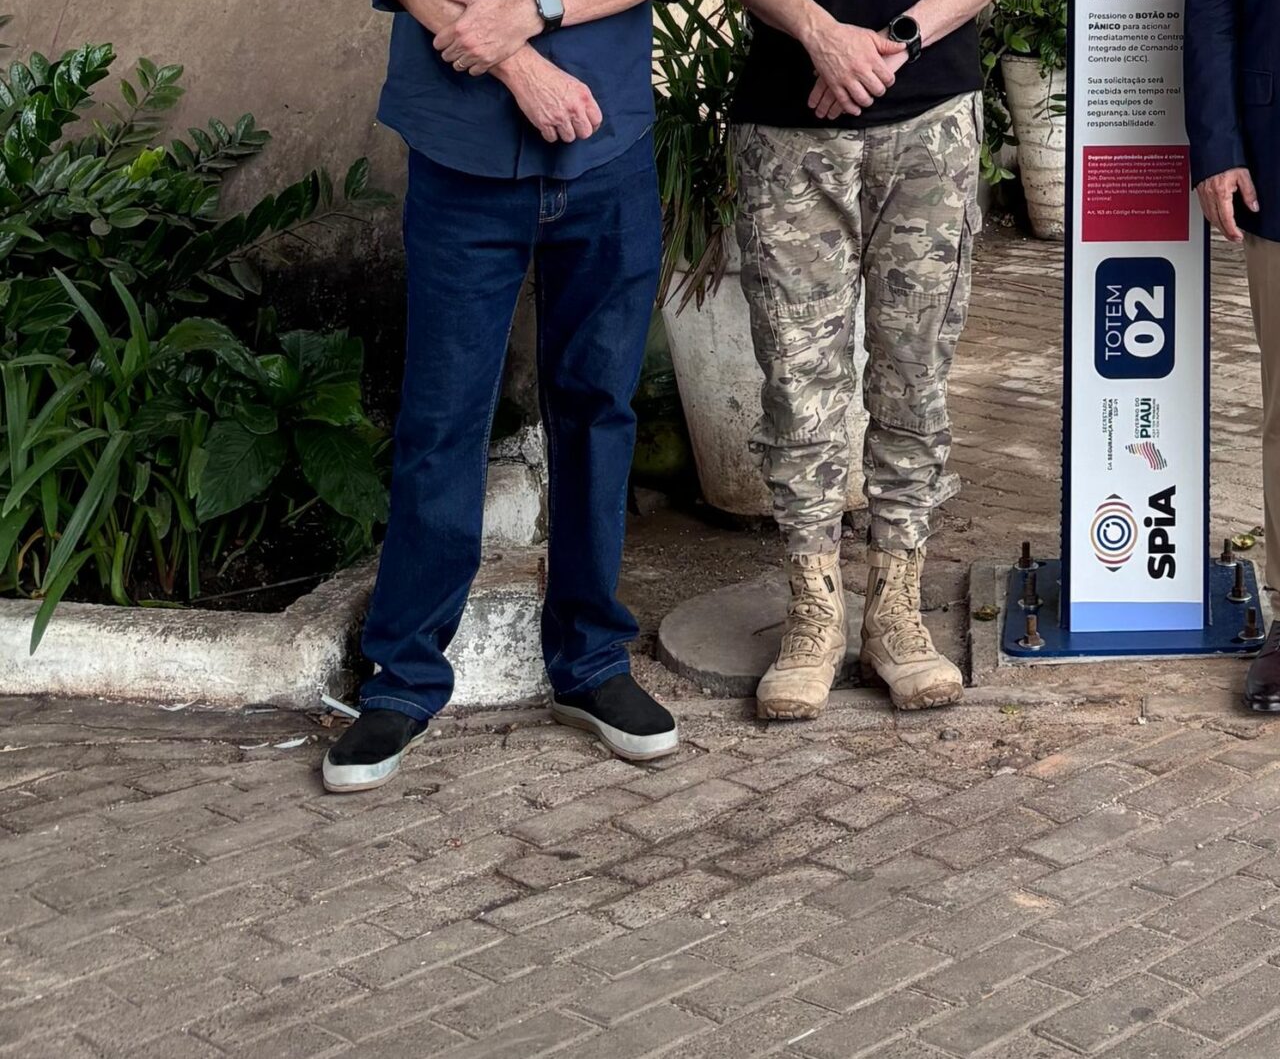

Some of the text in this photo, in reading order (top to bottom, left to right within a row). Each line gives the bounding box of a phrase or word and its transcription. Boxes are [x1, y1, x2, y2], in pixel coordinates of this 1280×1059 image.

[1135, 11, 1165, 19] BOTÃO
[1088, 22, 1121, 30] PÂNICO
[1088, 44, 1127, 52] Integrado
[1104, 77, 1146, 85] solicitação
[1148, 76, 1164, 84] será
[1138, 88, 1165, 96] tempo
[1088, 98, 1109, 106] pelas
[1110, 98, 1141, 106] equipes
[1087, 120, 1157, 128] responsabilidade.
[1105, 285, 1122, 361] TOTEM
[1123, 286, 1165, 358] 02
